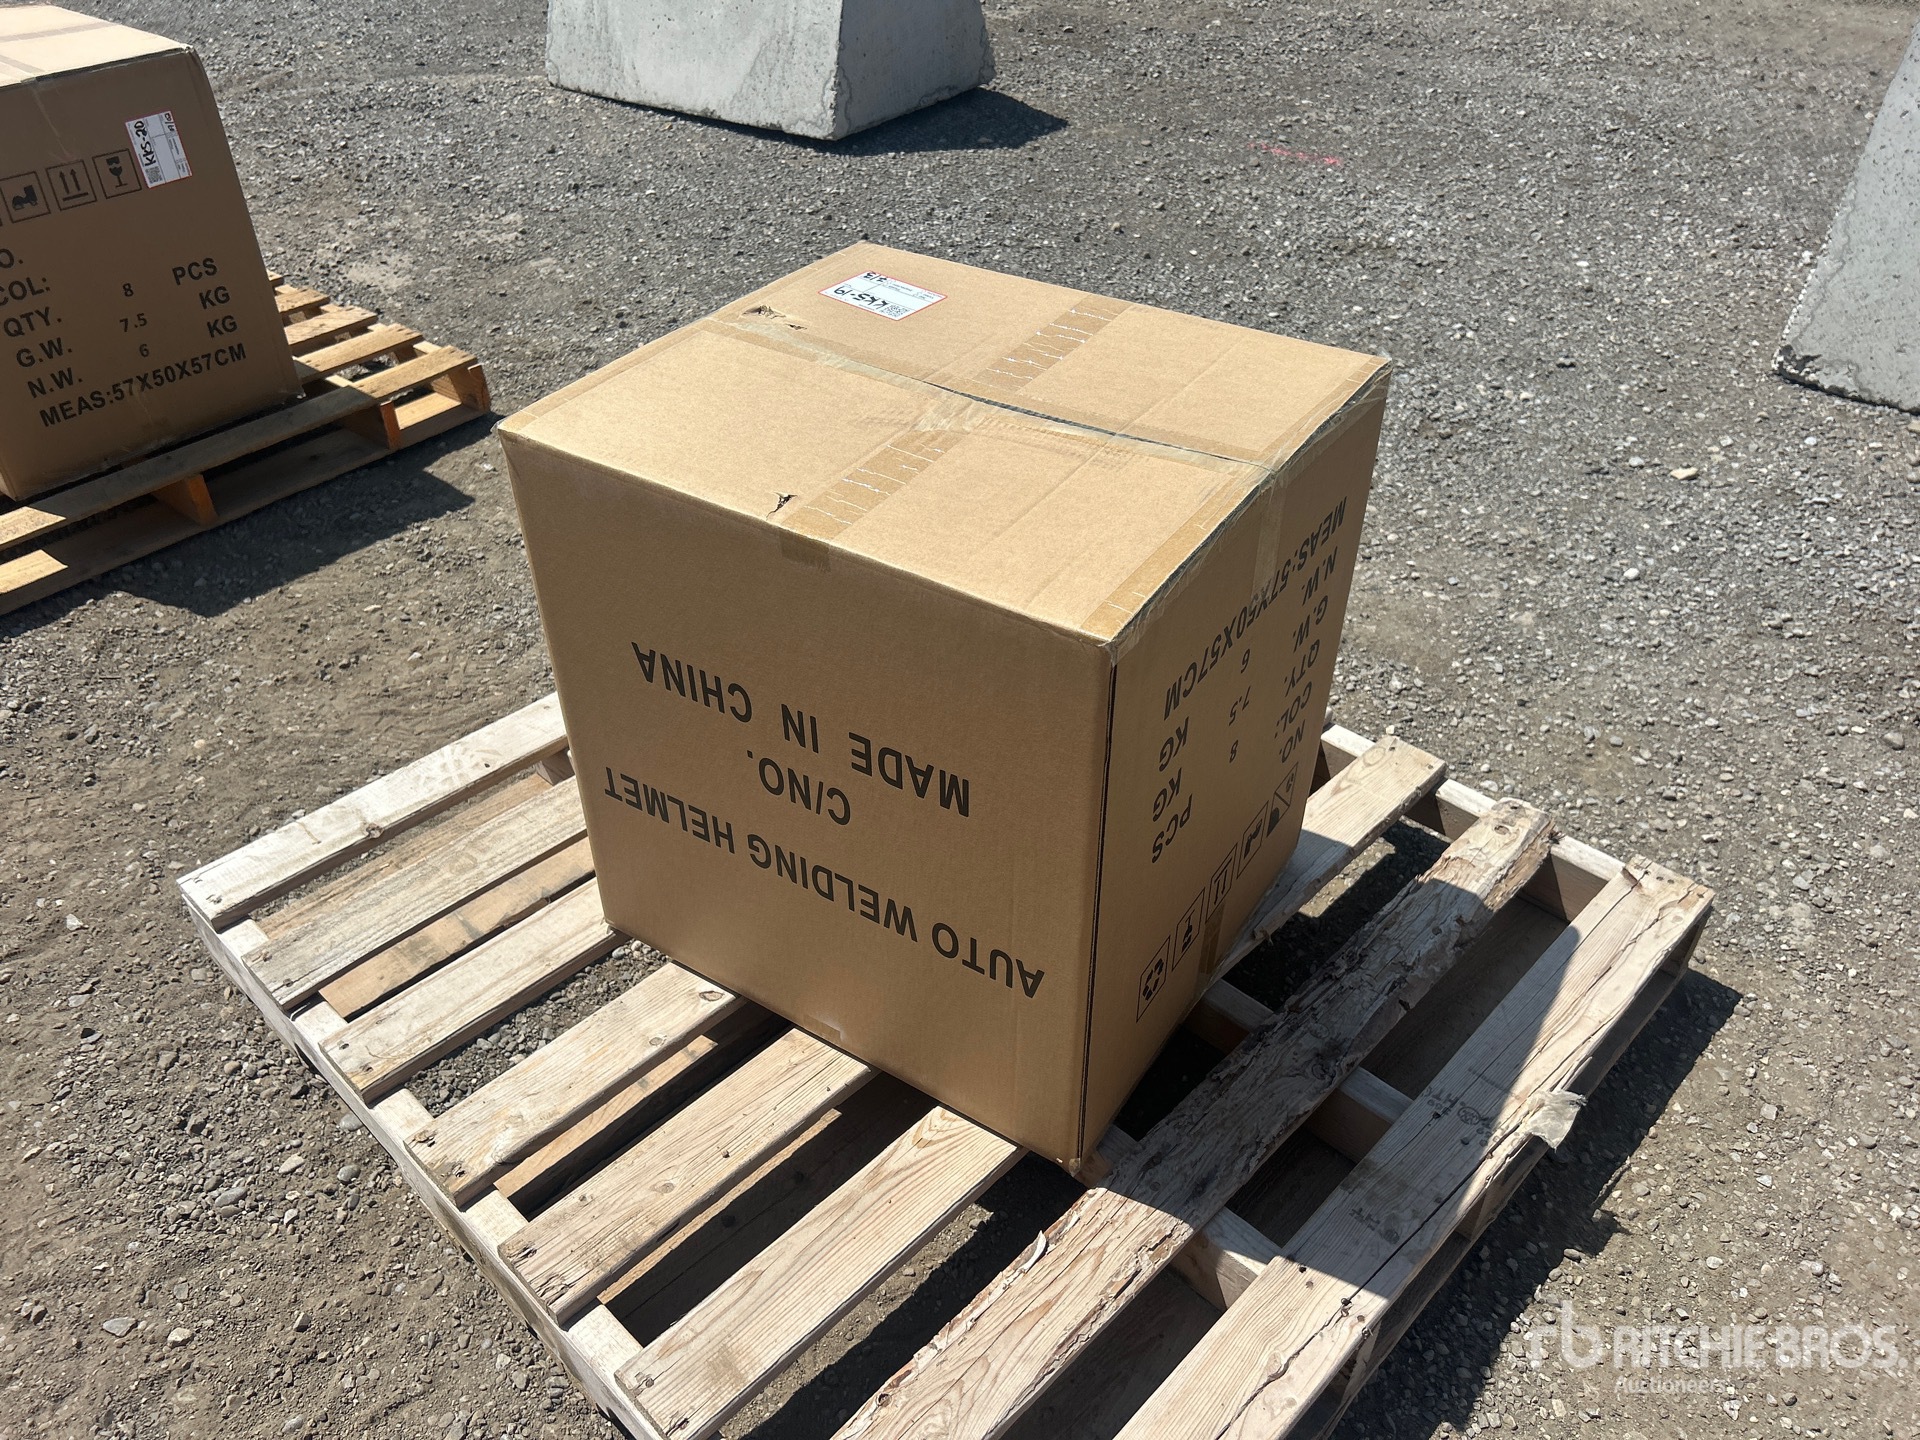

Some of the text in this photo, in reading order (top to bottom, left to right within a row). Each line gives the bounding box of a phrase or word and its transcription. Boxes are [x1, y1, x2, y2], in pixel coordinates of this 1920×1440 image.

[3, 257, 218, 338] QTY. 8 PCS
[16, 285, 231, 368] G.W. 7.5 KG
[27, 315, 238, 398] N.W. 6 KG
[1158, 546, 1338, 772] N.W. 6 KG
[631, 641, 970, 818] MADE IN CHINA
[1152, 595, 1328, 822] G.W. 7.5 KG
[1274, 681, 1312, 739] COL:
[1279, 719, 1305, 764] NO.
[746, 749, 851, 826] C/NO.
[1151, 639, 1320, 864] QTY. 8 PCS
[604, 766, 1045, 999] AUTO WELDING HELMET
